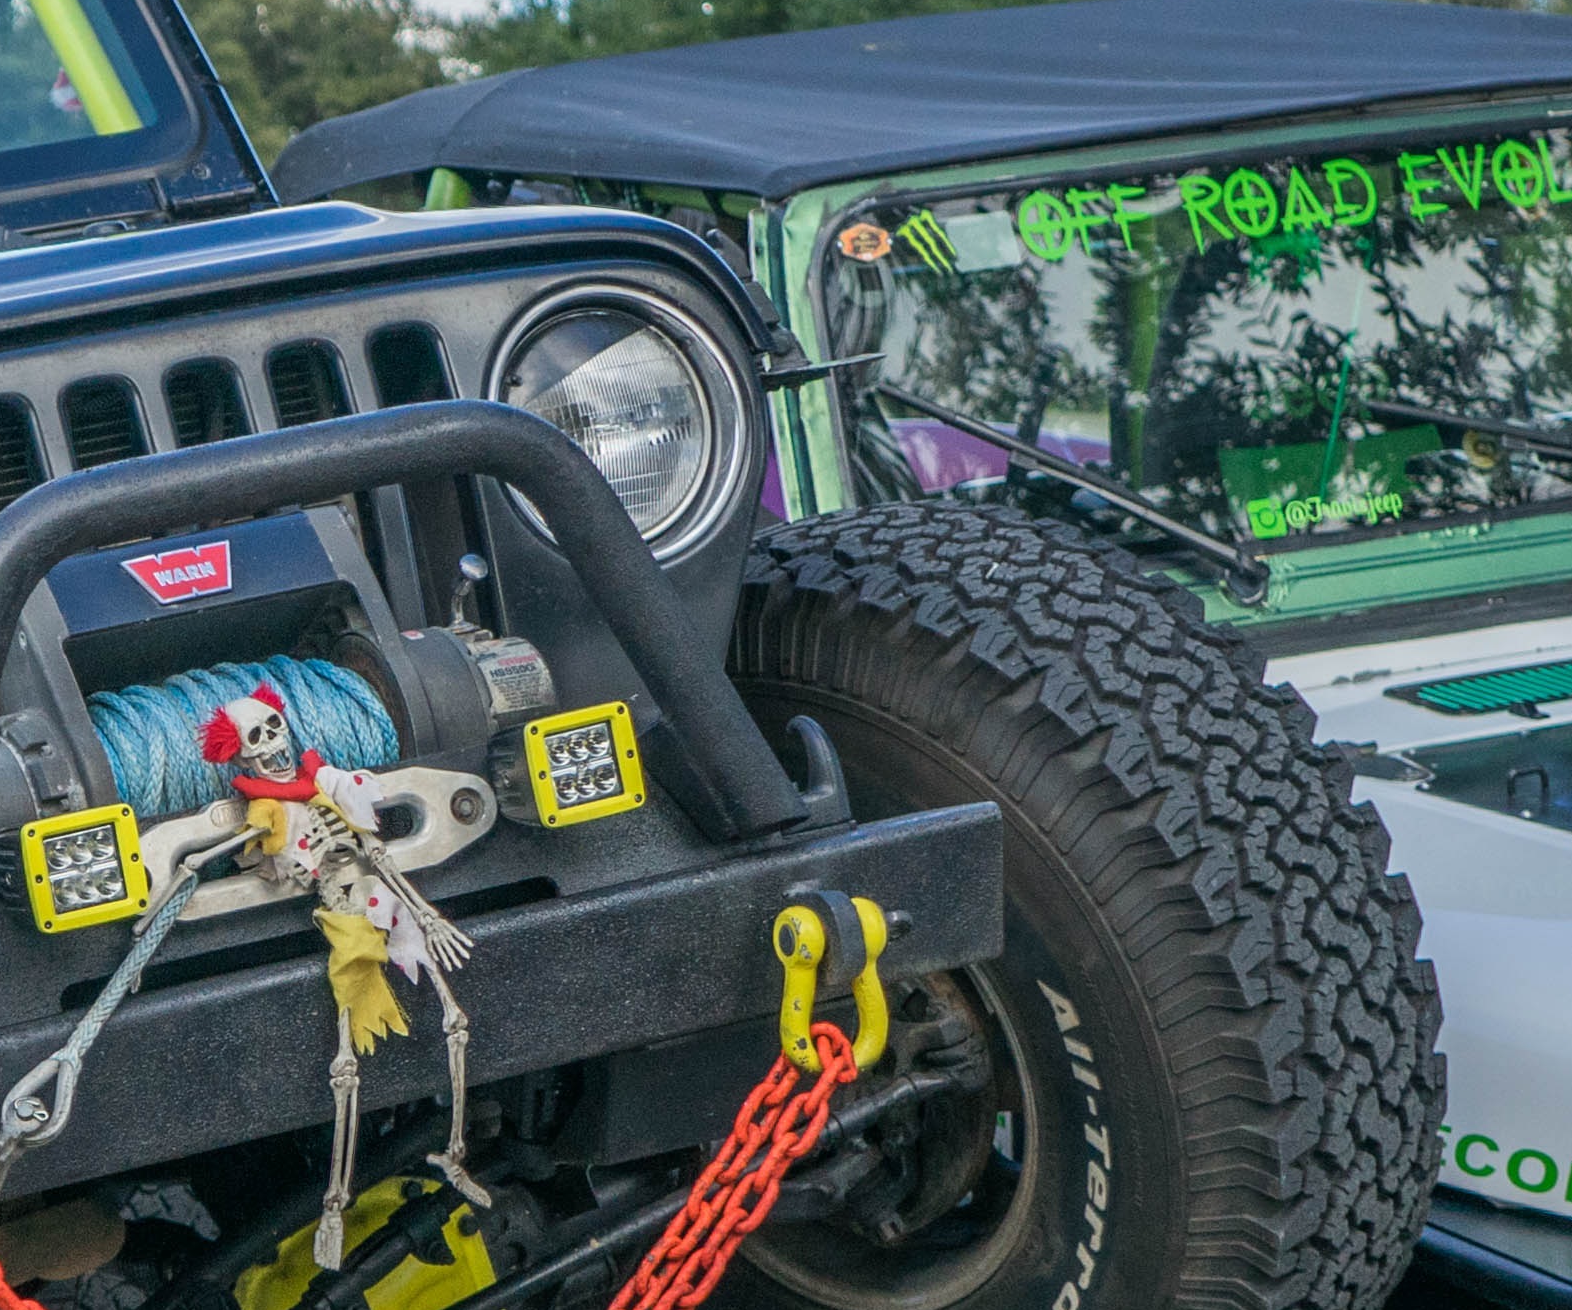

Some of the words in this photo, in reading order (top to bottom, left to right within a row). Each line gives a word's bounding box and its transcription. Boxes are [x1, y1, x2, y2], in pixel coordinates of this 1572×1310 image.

[1018, 184, 1153, 261] OFF
[1177, 158, 1378, 256] ROAD
[153, 561, 217, 587] WARN
